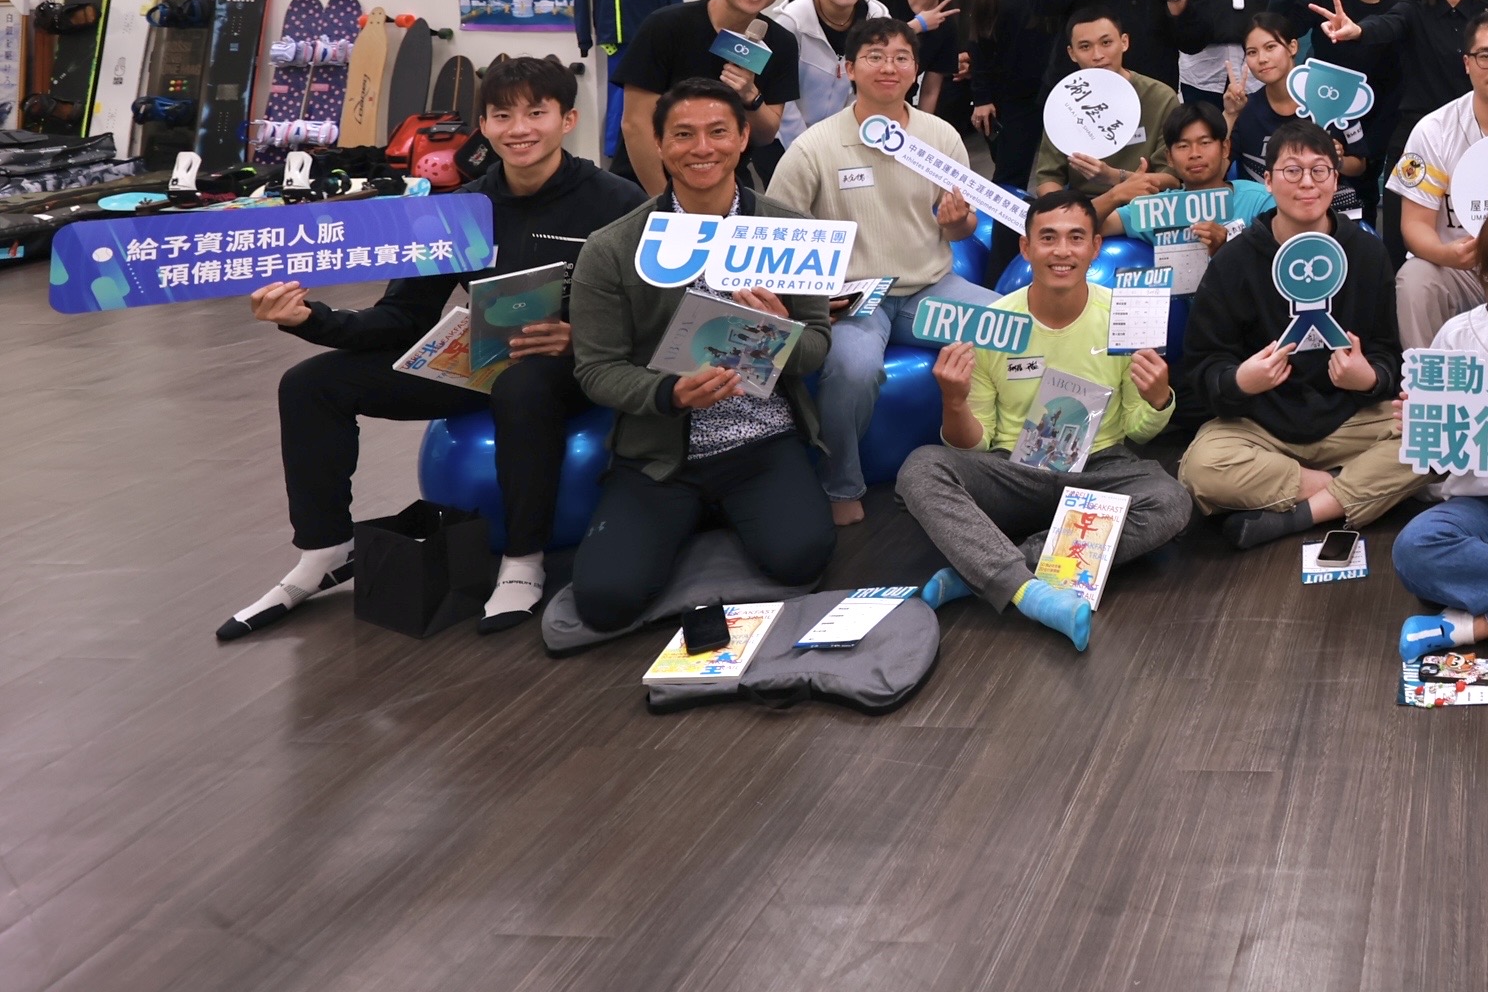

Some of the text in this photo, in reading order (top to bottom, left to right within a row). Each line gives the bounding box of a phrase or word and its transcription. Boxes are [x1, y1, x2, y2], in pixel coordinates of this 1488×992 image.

[902, 154, 924, 171] Athletes
[925, 168, 942, 181] Based
[962, 189, 999, 215] Development
[908, 143, 1028, 219] 中華民國運動員生涯規劃發展協
[1134, 191, 1229, 229] TRY OUT
[126, 221, 345, 262] 給予資源和人脈
[731, 225, 847, 244] 屋馬餐飲集團
[1155, 230, 1183, 247] TRY
[158, 239, 453, 289] 預備選手面對真實未來
[724, 245, 841, 277] UMAI
[721, 277, 835, 290] CORPORATION
[1116, 268, 1173, 288] TRY OUT
[862, 278, 894, 316] TRY OUT
[923, 300, 1029, 351] TRY OUT
[1065, 493, 1097, 510] 台北
[851, 586, 918, 598] TRY OUT
[1303, 569, 1366, 584] TRY OUT
